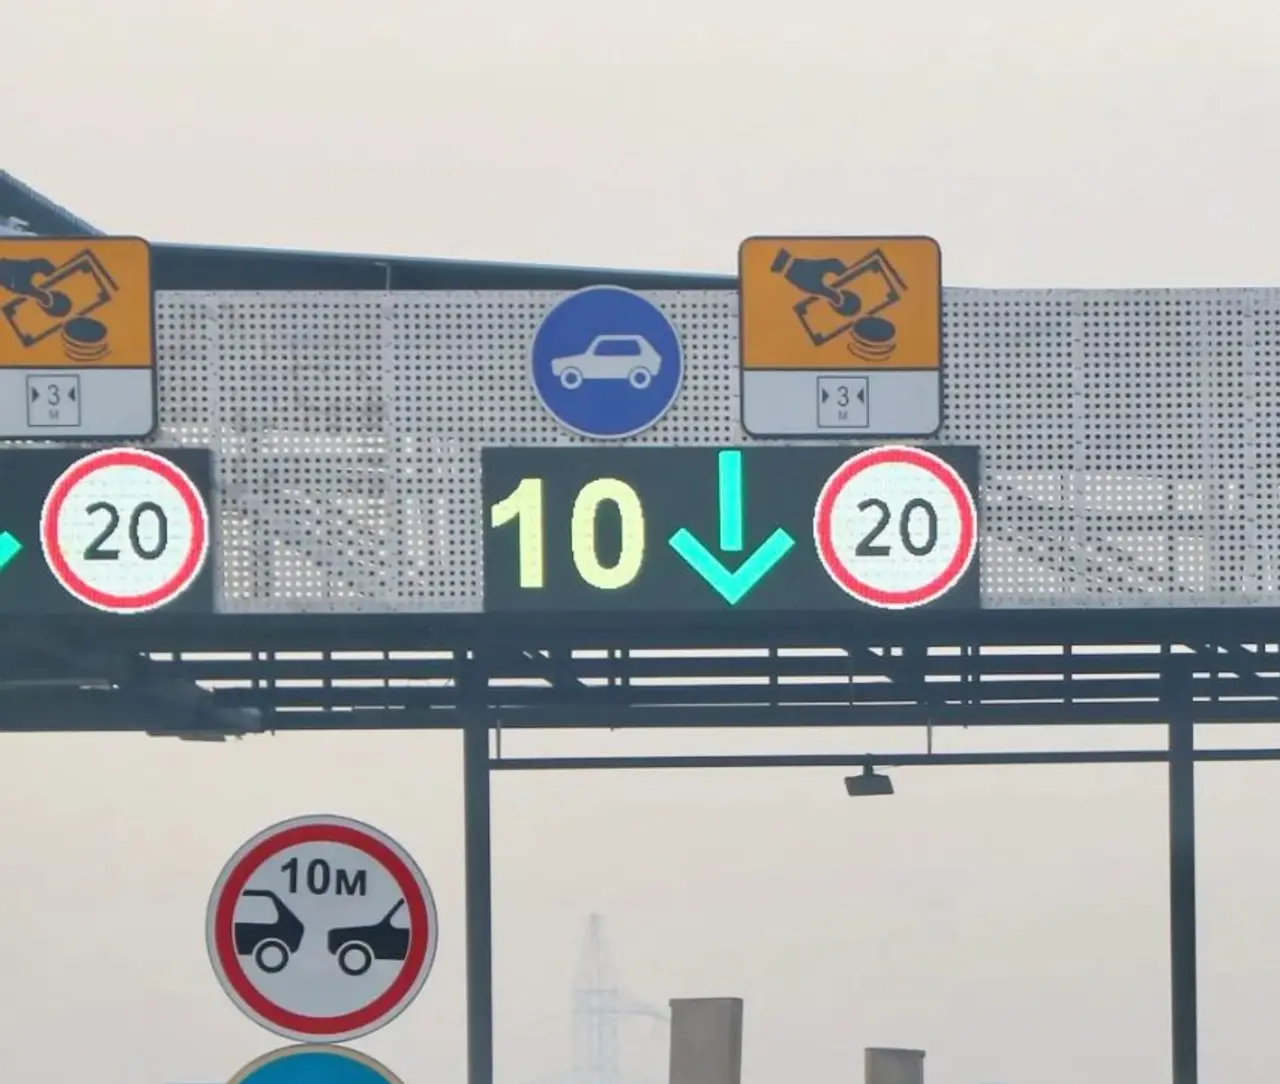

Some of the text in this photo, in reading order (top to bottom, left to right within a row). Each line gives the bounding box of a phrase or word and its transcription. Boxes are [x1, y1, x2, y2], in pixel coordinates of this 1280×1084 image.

[47, 383, 61, 406] 3
[837, 385, 850, 407] 3
[83, 500, 169, 561] 20
[491, 477, 646, 590] 10
[854, 497, 939, 557] 20
